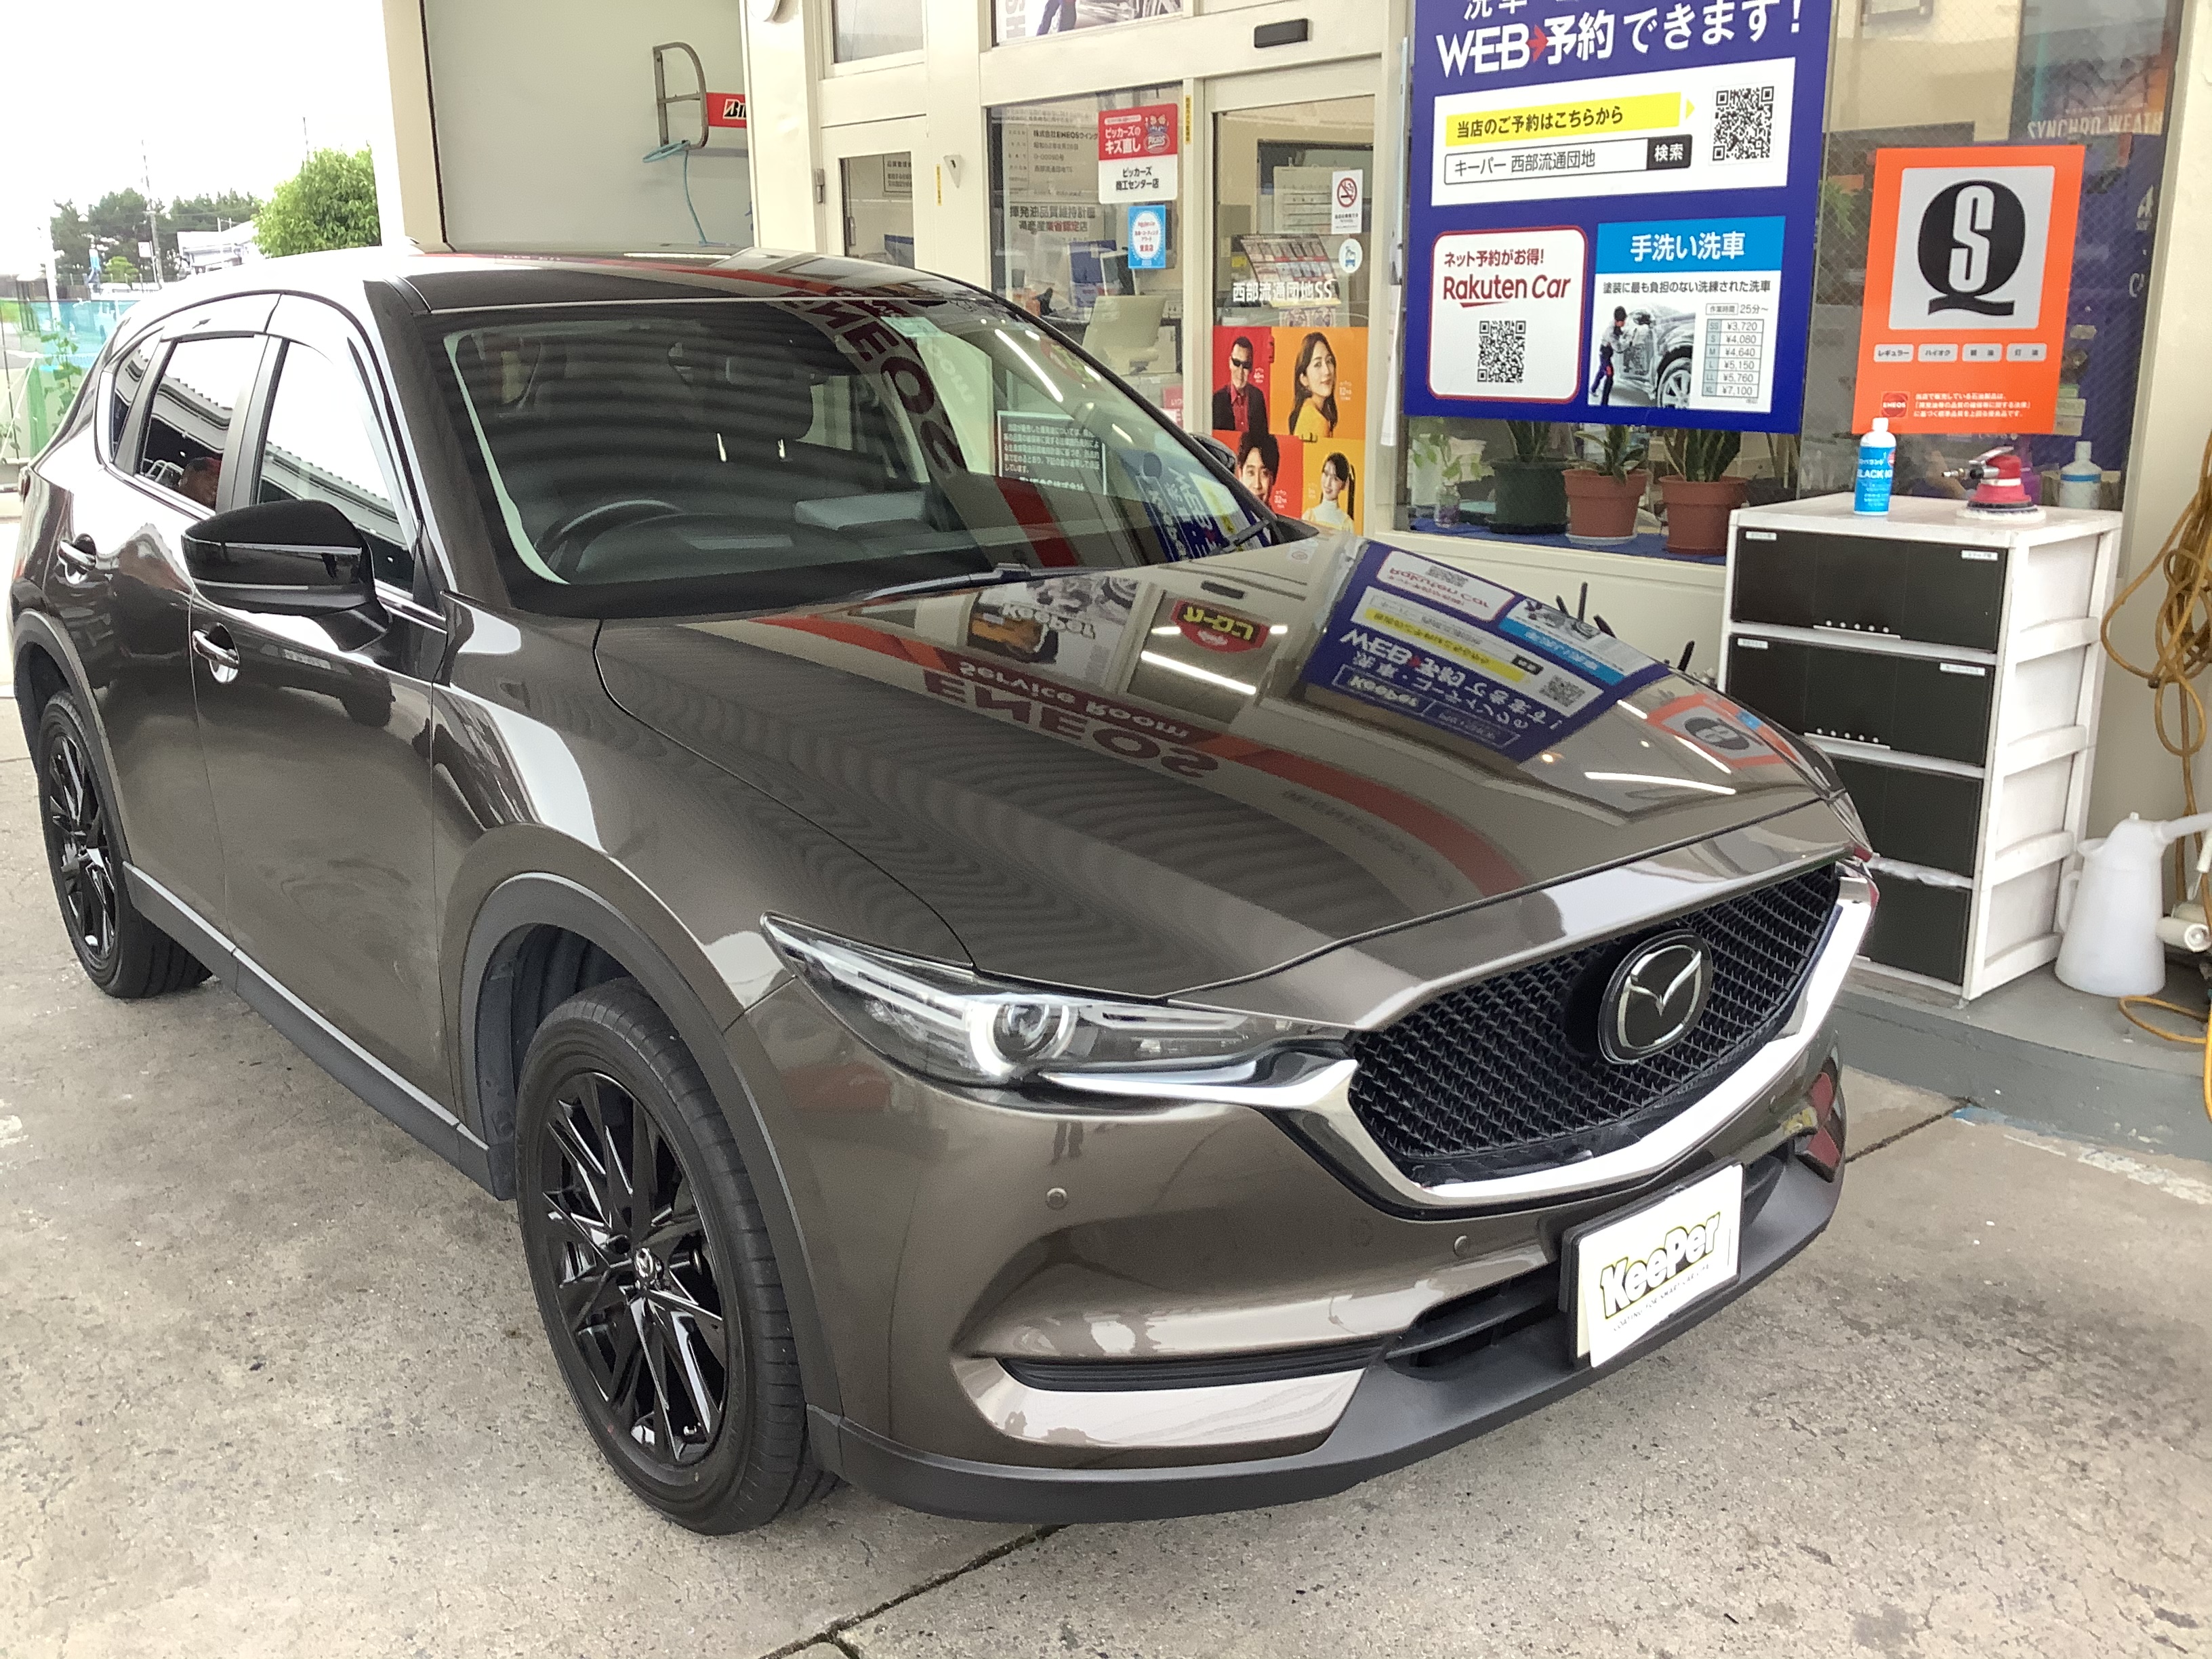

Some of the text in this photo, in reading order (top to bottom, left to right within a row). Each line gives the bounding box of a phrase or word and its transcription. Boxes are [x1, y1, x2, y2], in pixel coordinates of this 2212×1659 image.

[1436, 23, 1530, 78] WEB
[1457, 106, 1624, 138] 当店のご予約はこちらから
[1454, 143, 1684, 178] キーパー 西部流通団地 検索
[1630, 230, 1746, 262] 手洗い洗車
[1443, 274, 1572, 300] Rakuten Car
[1603, 280, 1771, 294] 塗装に最も負担のない洗練された洗車
[1599, 1211, 1721, 1319] KeePer
